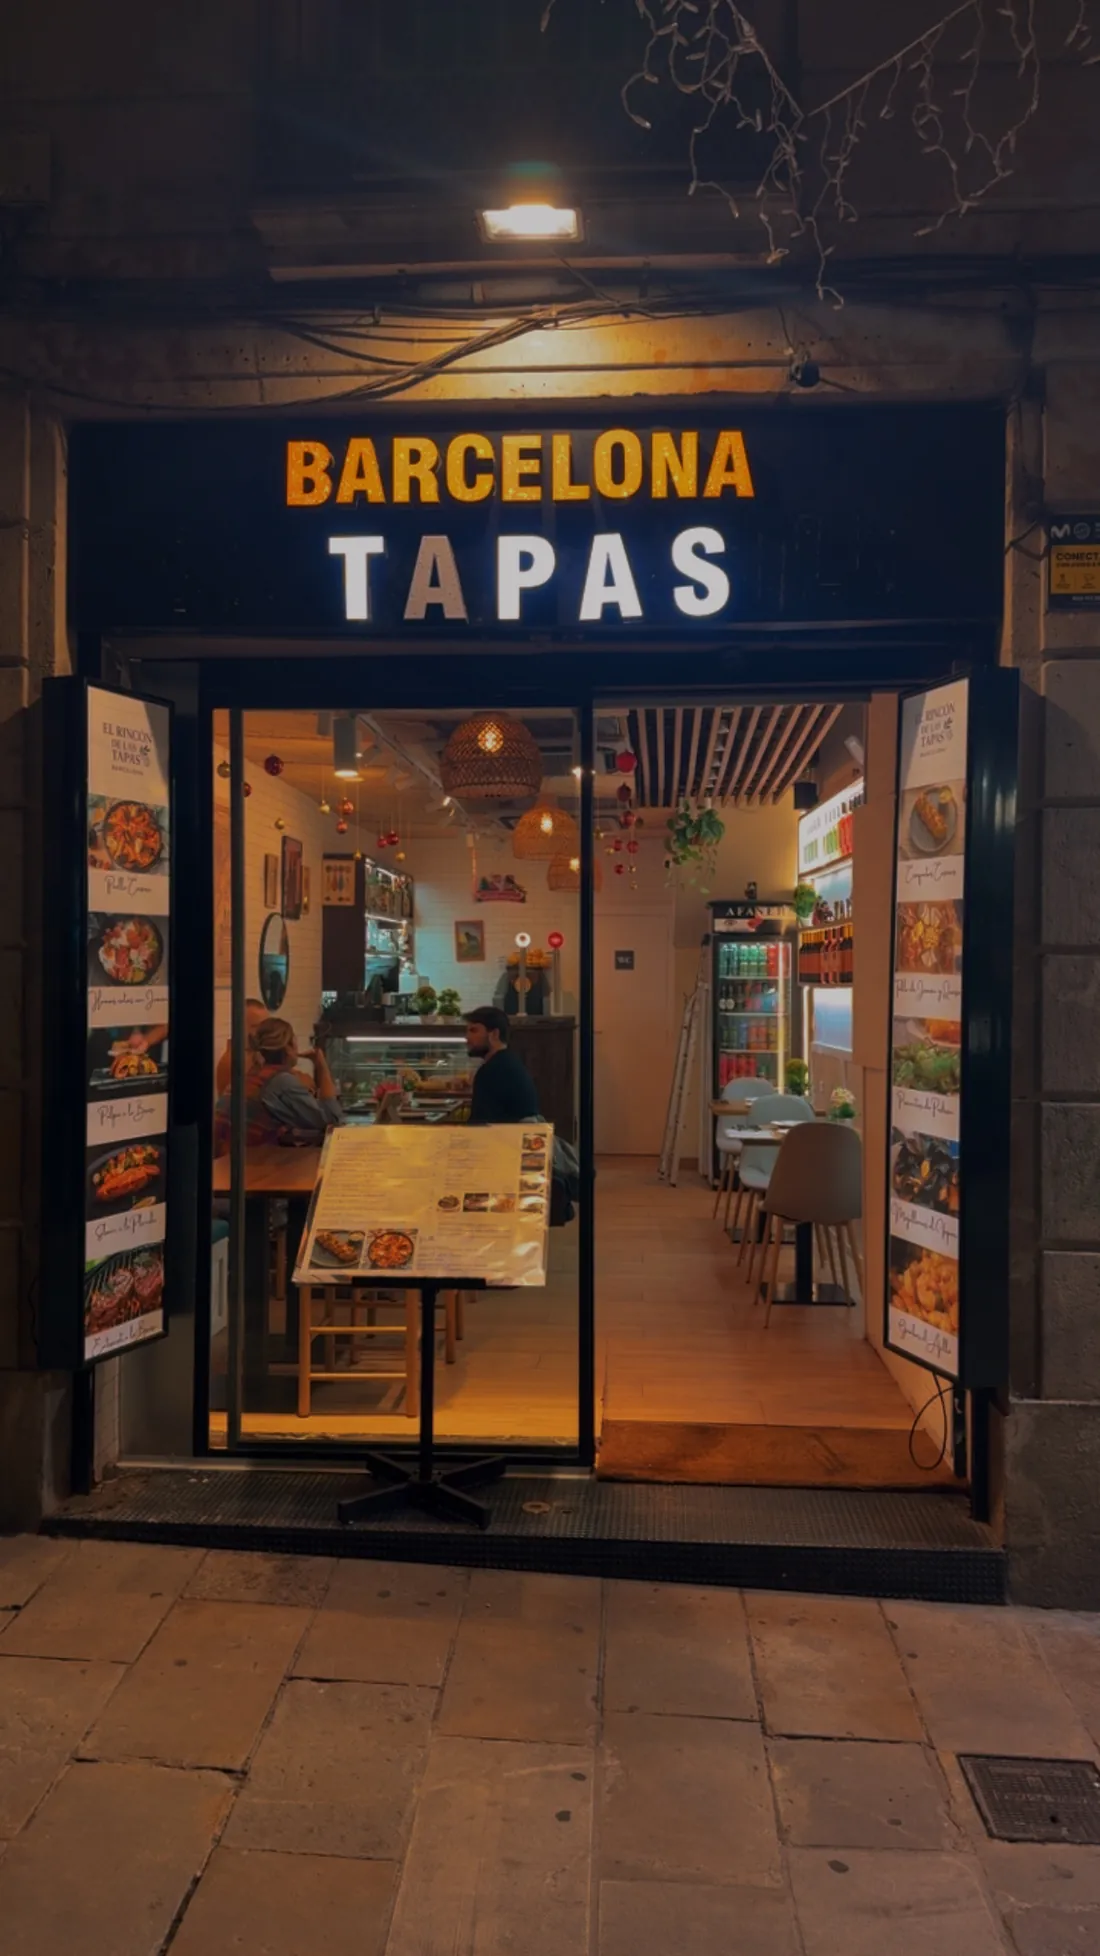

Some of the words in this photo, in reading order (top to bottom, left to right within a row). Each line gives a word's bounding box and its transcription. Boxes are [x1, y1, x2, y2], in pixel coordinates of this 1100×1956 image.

[286, 428, 755, 506] BARCELONA
[1056, 552, 1100, 561] CONECT
[328, 526, 730, 621] TAPAS
[103, 722, 114, 735] EL
[116, 725, 152, 743] RINCÓN
[921, 733, 945, 747] TAPAS
[112, 749, 141, 765] TAPAS
